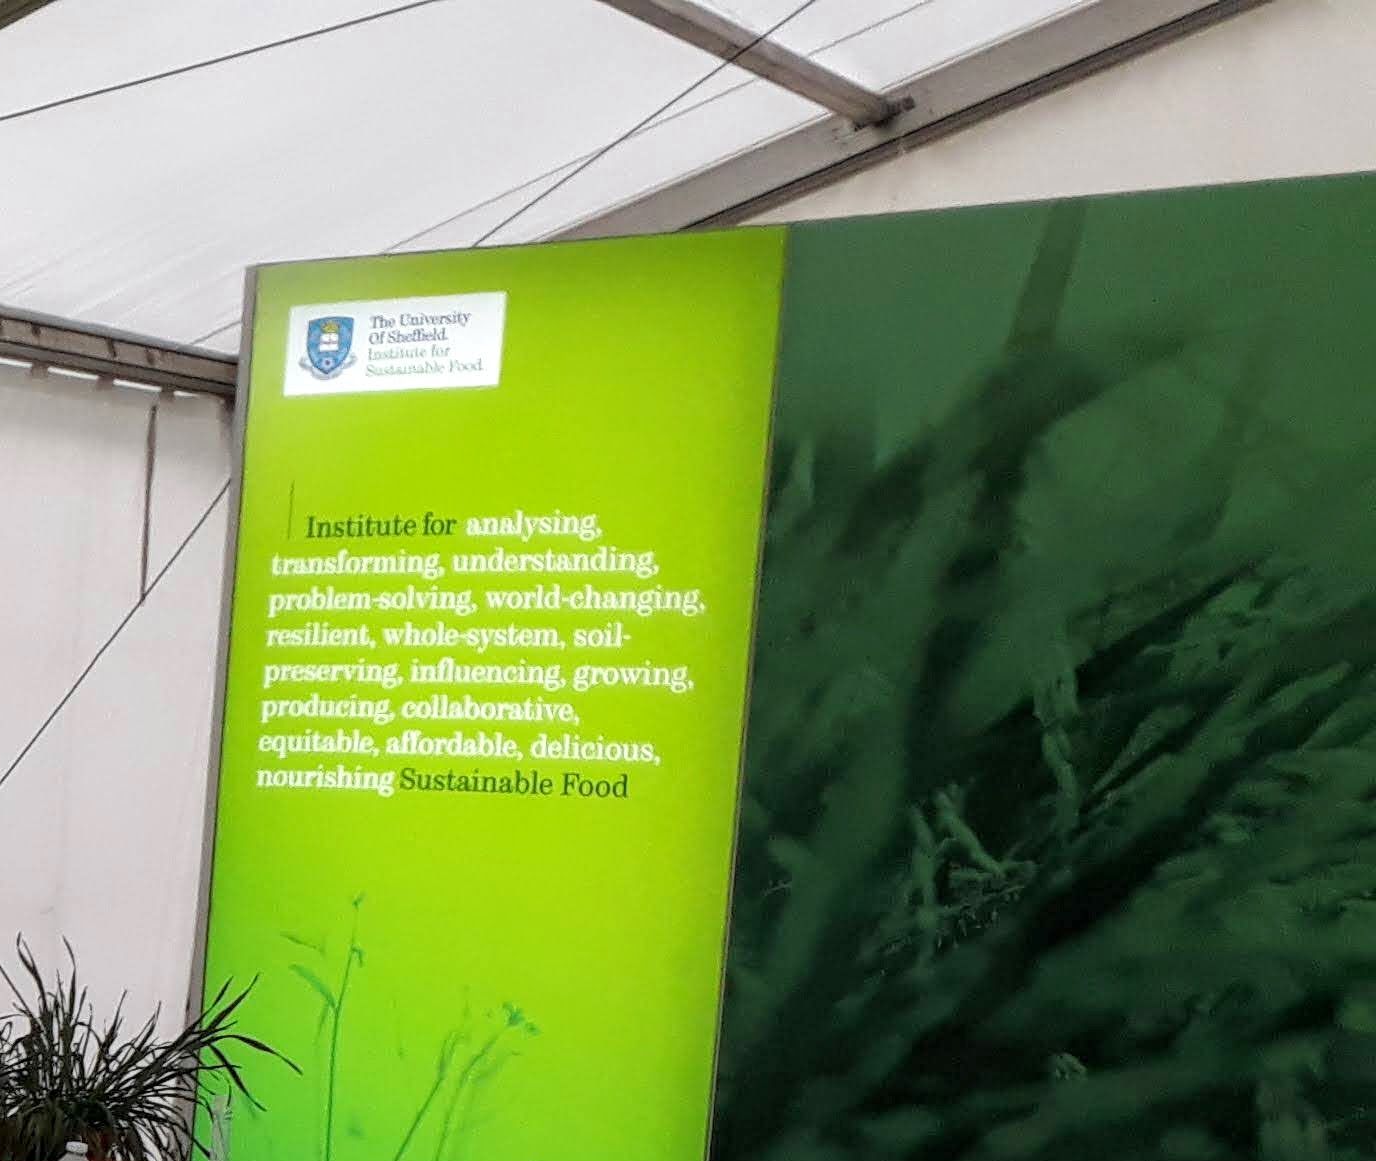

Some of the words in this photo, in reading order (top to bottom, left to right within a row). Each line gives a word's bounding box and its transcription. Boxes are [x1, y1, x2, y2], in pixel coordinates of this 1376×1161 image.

[370, 315, 395, 329] The
[400, 311, 472, 328] University
[368, 347, 426, 361] Institute
[431, 345, 451, 357] for
[369, 332, 385, 344] Of
[365, 361, 445, 377] Sustainable
[306, 514, 416, 540] Institute
[423, 511, 456, 536] for
[466, 510, 602, 542] analysing,
[271, 550, 445, 578] transforming,
[452, 549, 659, 578] understanding,
[268, 587, 477, 618] problem-solving,
[485, 584, 705, 616] world-changing,
[266, 621, 375, 650] resilient,
[383, 622, 566, 653] whole-system,
[574, 622, 630, 649] soil-
[263, 660, 403, 690] preserving,
[410, 658, 566, 690] influencing,
[573, 662, 694, 693] growing,
[260, 695, 396, 726] producing,
[401, 696, 579, 727] collaborative,
[258, 731, 378, 762] equitable,
[386, 731, 523, 762] affordable,
[530, 733, 660, 765] delicious,
[256, 767, 395, 797] nourishing
[399, 767, 553, 797] Sustainable
[561, 772, 629, 799] Food
